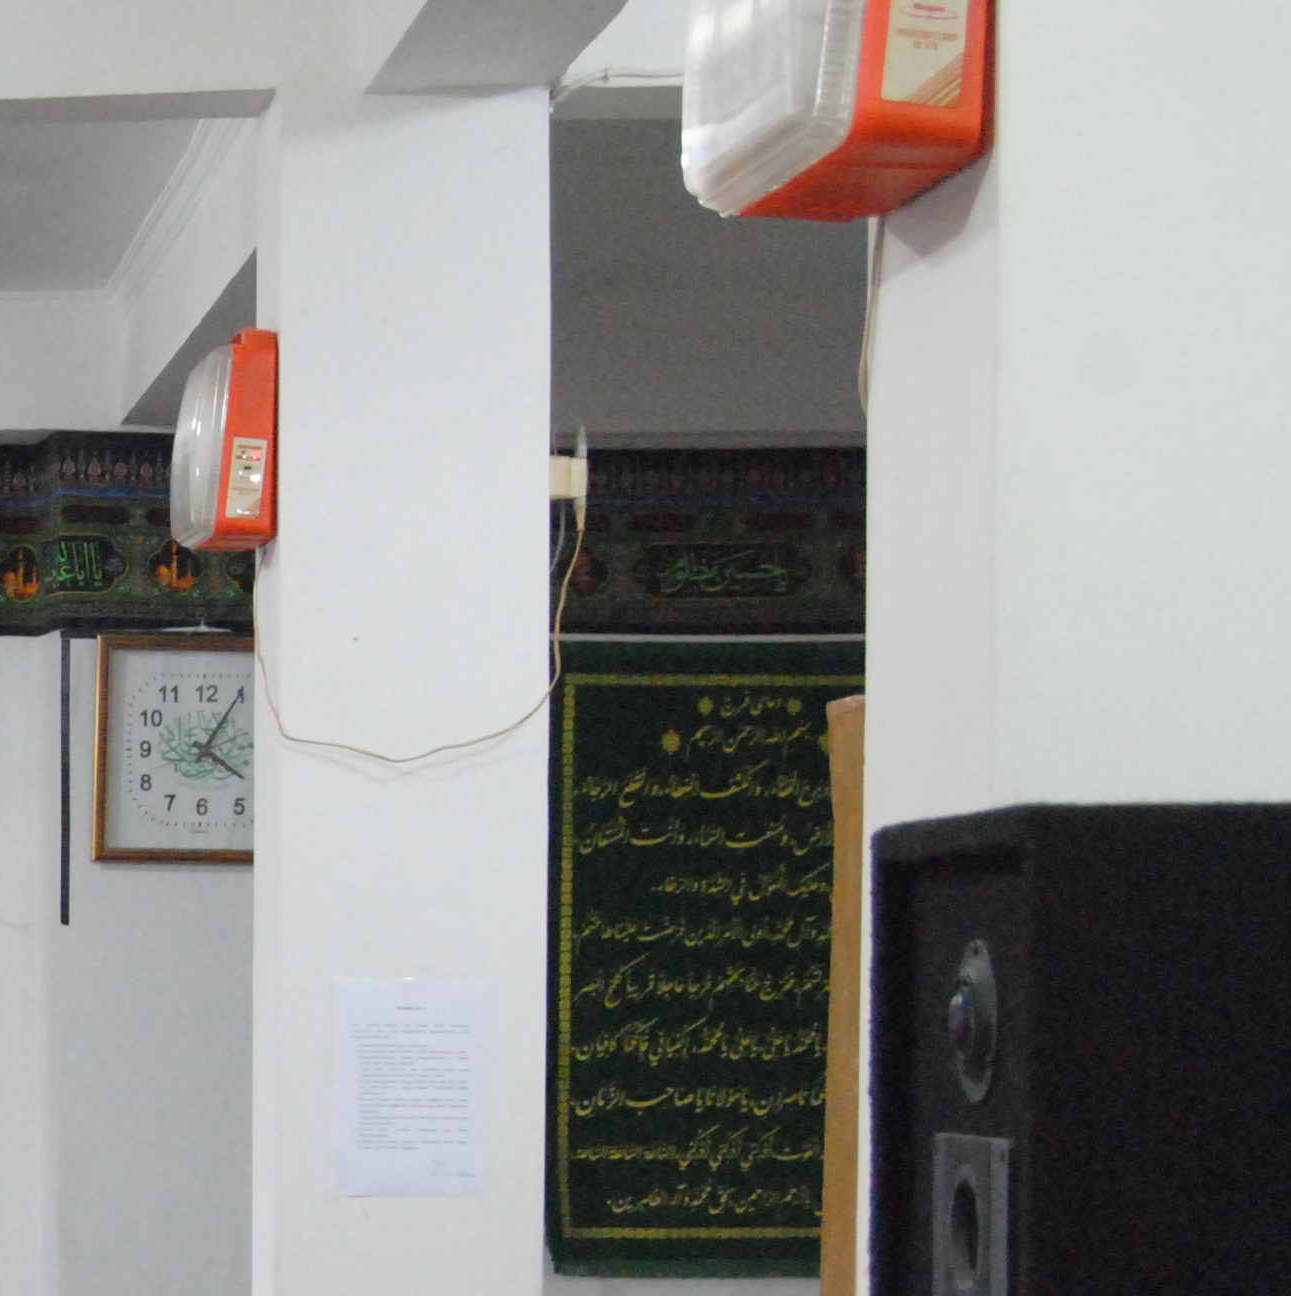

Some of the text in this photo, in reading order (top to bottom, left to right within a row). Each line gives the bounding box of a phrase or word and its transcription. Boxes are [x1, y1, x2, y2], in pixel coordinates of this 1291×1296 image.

[159, 685, 178, 703] 11
[196, 685, 218, 703] 12
[140, 709, 163, 727] 10
[140, 740, 151, 758] 9
[140, 774, 152, 791] 8
[164, 794, 176, 812] 7
[196, 798, 208, 816] 6
[234, 798, 245, 815] 5
